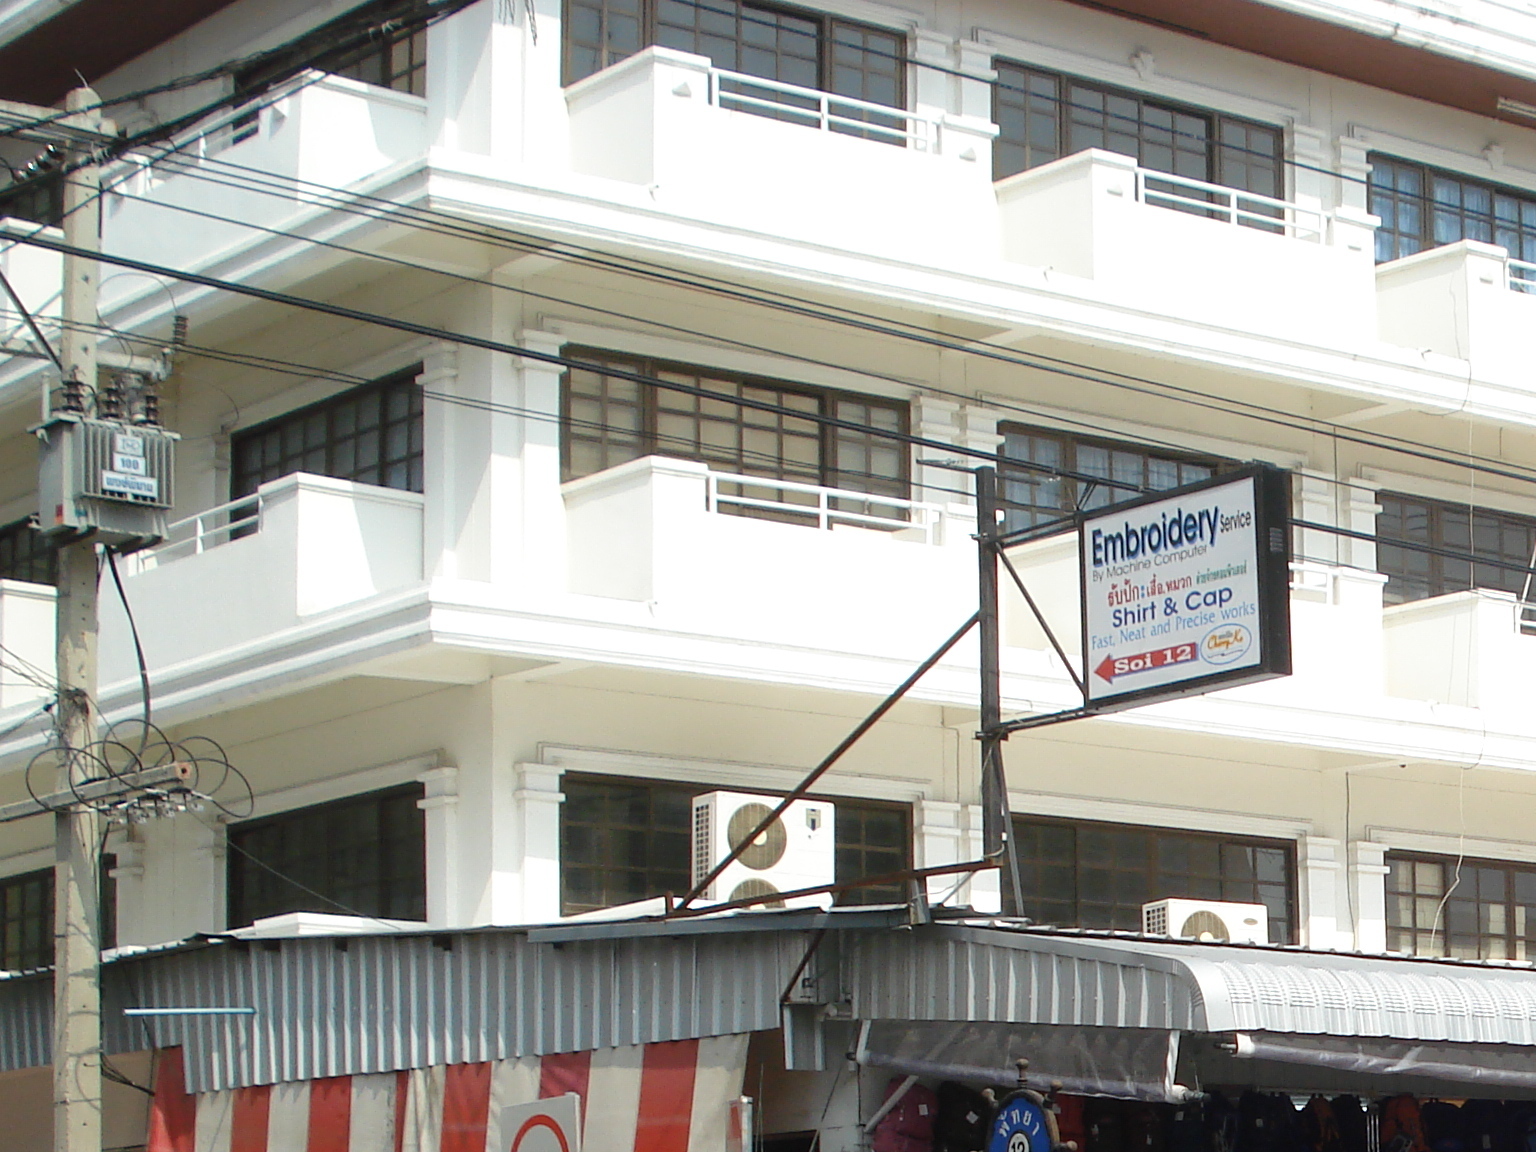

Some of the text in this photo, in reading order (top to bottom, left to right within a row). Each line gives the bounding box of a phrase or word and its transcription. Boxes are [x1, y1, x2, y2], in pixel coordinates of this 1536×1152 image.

[1092, 506, 1252, 567] Embroidery Service
[1092, 544, 1207, 583] By Machine Computer
[1092, 602, 1256, 651] Fast, Neat and Precise works
[1112, 587, 1233, 628] Shirt & Cap
[1114, 646, 1191, 675] Soi 12
[999, 1109, 1040, 1138] พัทยา
